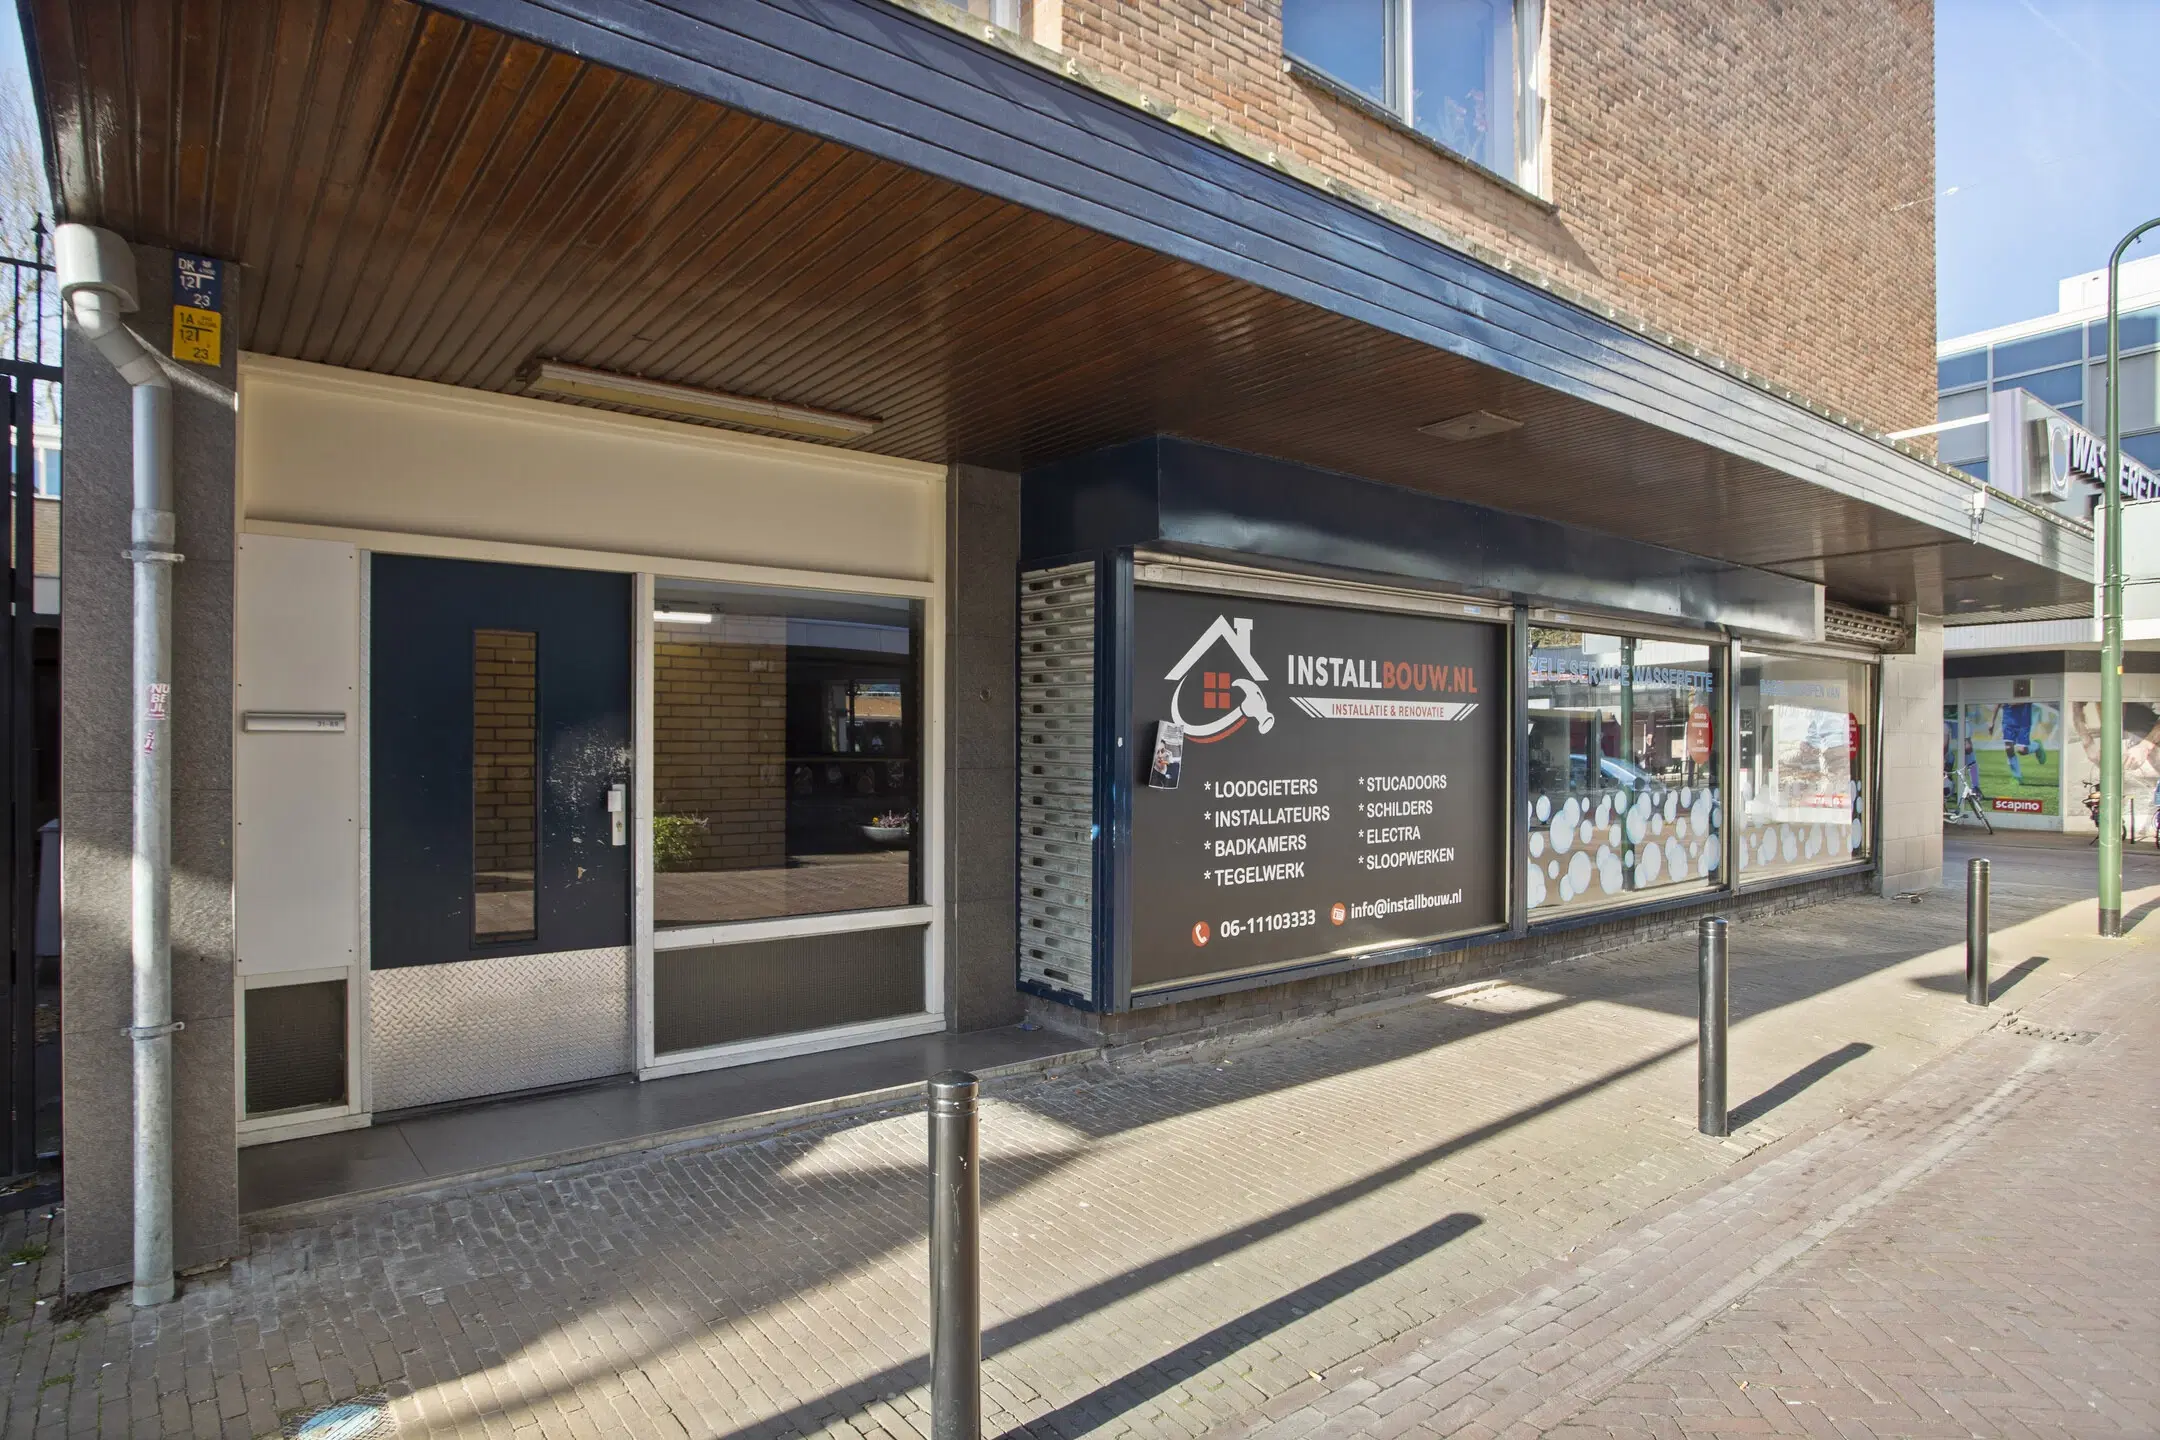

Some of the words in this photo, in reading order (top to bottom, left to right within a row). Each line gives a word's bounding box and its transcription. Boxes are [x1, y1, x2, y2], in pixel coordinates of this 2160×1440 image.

[2072, 427, 2160, 500] WASERETT
[1288, 654, 1478, 693] INSTALLBOUW.NL
[1569, 660, 1630, 687] SERVICE
[1633, 665, 1713, 693] WASSERETTE
[1332, 703, 1389, 717] INSTALLATIE
[1391, 706, 1397, 717] &
[1399, 706, 1445, 718] RENOVATIE
[1215, 778, 1318, 798] LOODGIETERS
[1367, 775, 1447, 792] STUCADOORS
[1215, 805, 1330, 828] INSTALLATEURS
[1367, 800, 1433, 818] SCHILDERS
[1995, 800, 2040, 812] scapino
[1215, 834, 1307, 857] BADKAMERS
[1367, 826, 1421, 844] ELECTRA
[1366, 847, 1454, 871] SLOOPWERKEN
[1215, 862, 1305, 886] TEGELWERK
[1351, 889, 1462, 919] info@installbouw.nl
[1220, 909, 1316, 938] 06-11103333
